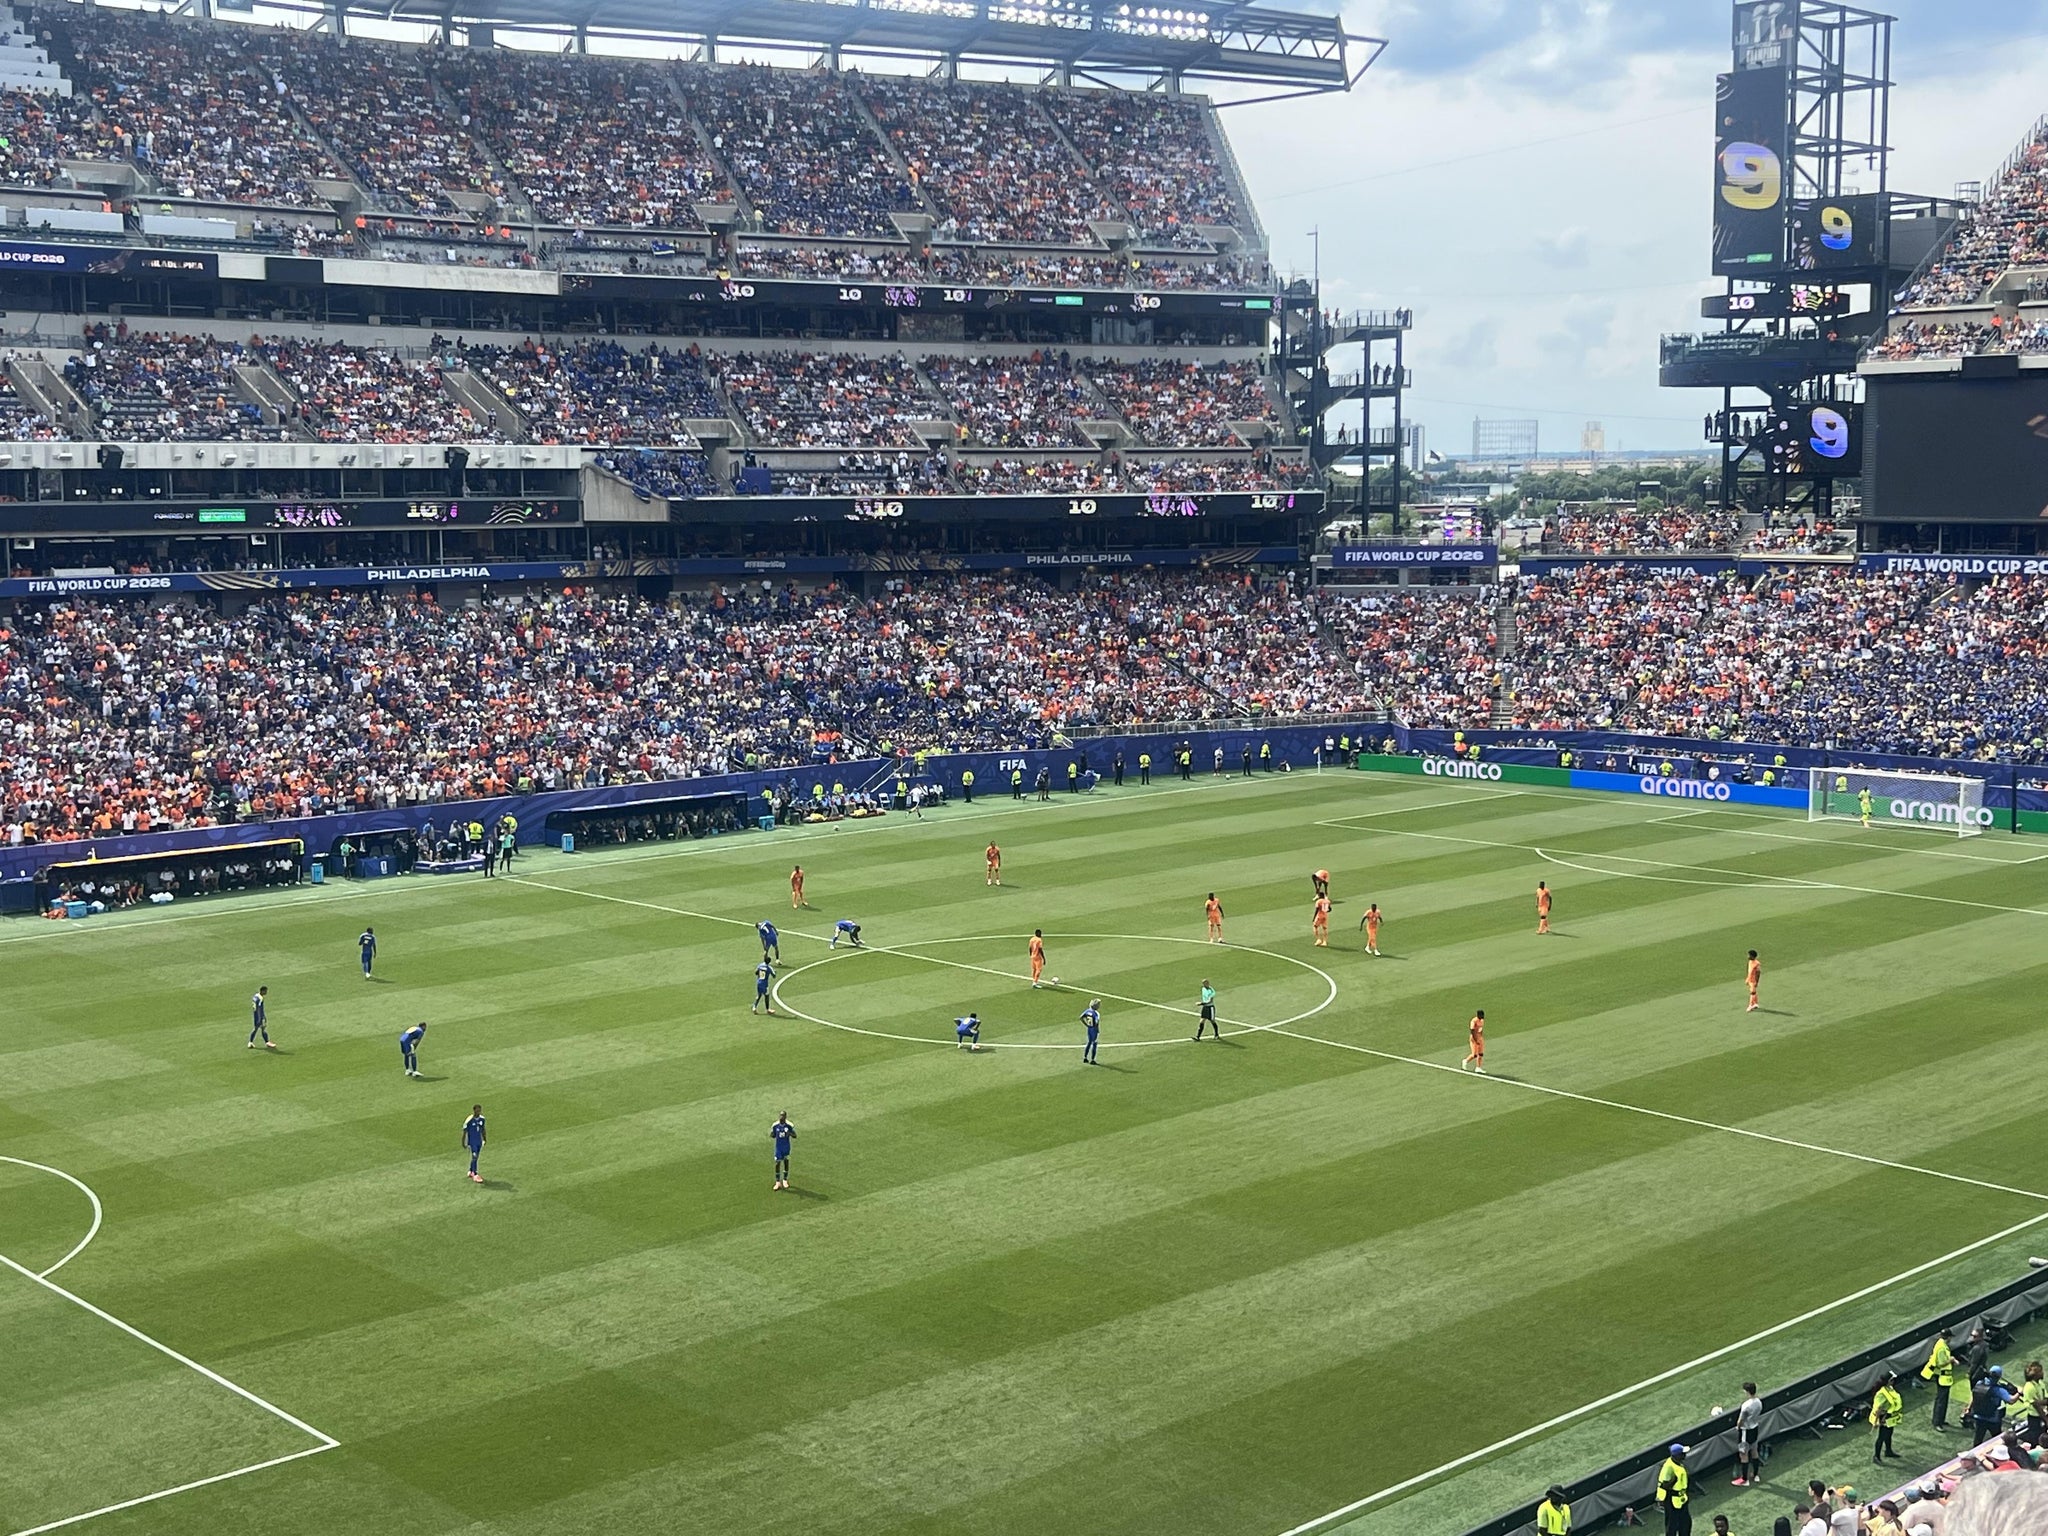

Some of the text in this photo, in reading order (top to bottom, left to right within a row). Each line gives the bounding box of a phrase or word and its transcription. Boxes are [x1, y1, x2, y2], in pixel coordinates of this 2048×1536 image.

[1721, 142, 1781, 210] 9
[1821, 207, 1853, 250] 9
[12, 252, 31, 262] CUP
[32, 253, 65, 264] 2026
[732, 284, 755, 297] 10
[839, 288, 862, 301] 10
[943, 288, 965, 302] 10
[1140, 296, 1161, 309] 10
[1728, 295, 1755, 310] 10
[1809, 406, 1850, 459] 9
[875, 500, 904, 517] 10
[1068, 499, 1097, 515] 10
[1026, 553, 1133, 565] PHILADELPHIA
[1345, 551, 1485, 562] FIFA WORLD CUP 2026
[367, 566, 491, 581] PHILADELPHIA
[1888, 558, 1923, 573] FIFA
[1925, 558, 1985, 574] WORLD
[1987, 559, 2020, 575] CUP
[28, 577, 171, 592] FIFA WORLD CUP 2026
[1000, 759, 1027, 771] FIFA
[1422, 758, 1502, 781] aramco
[1639, 776, 1731, 802] aramco
[1890, 800, 1994, 826] aramco
